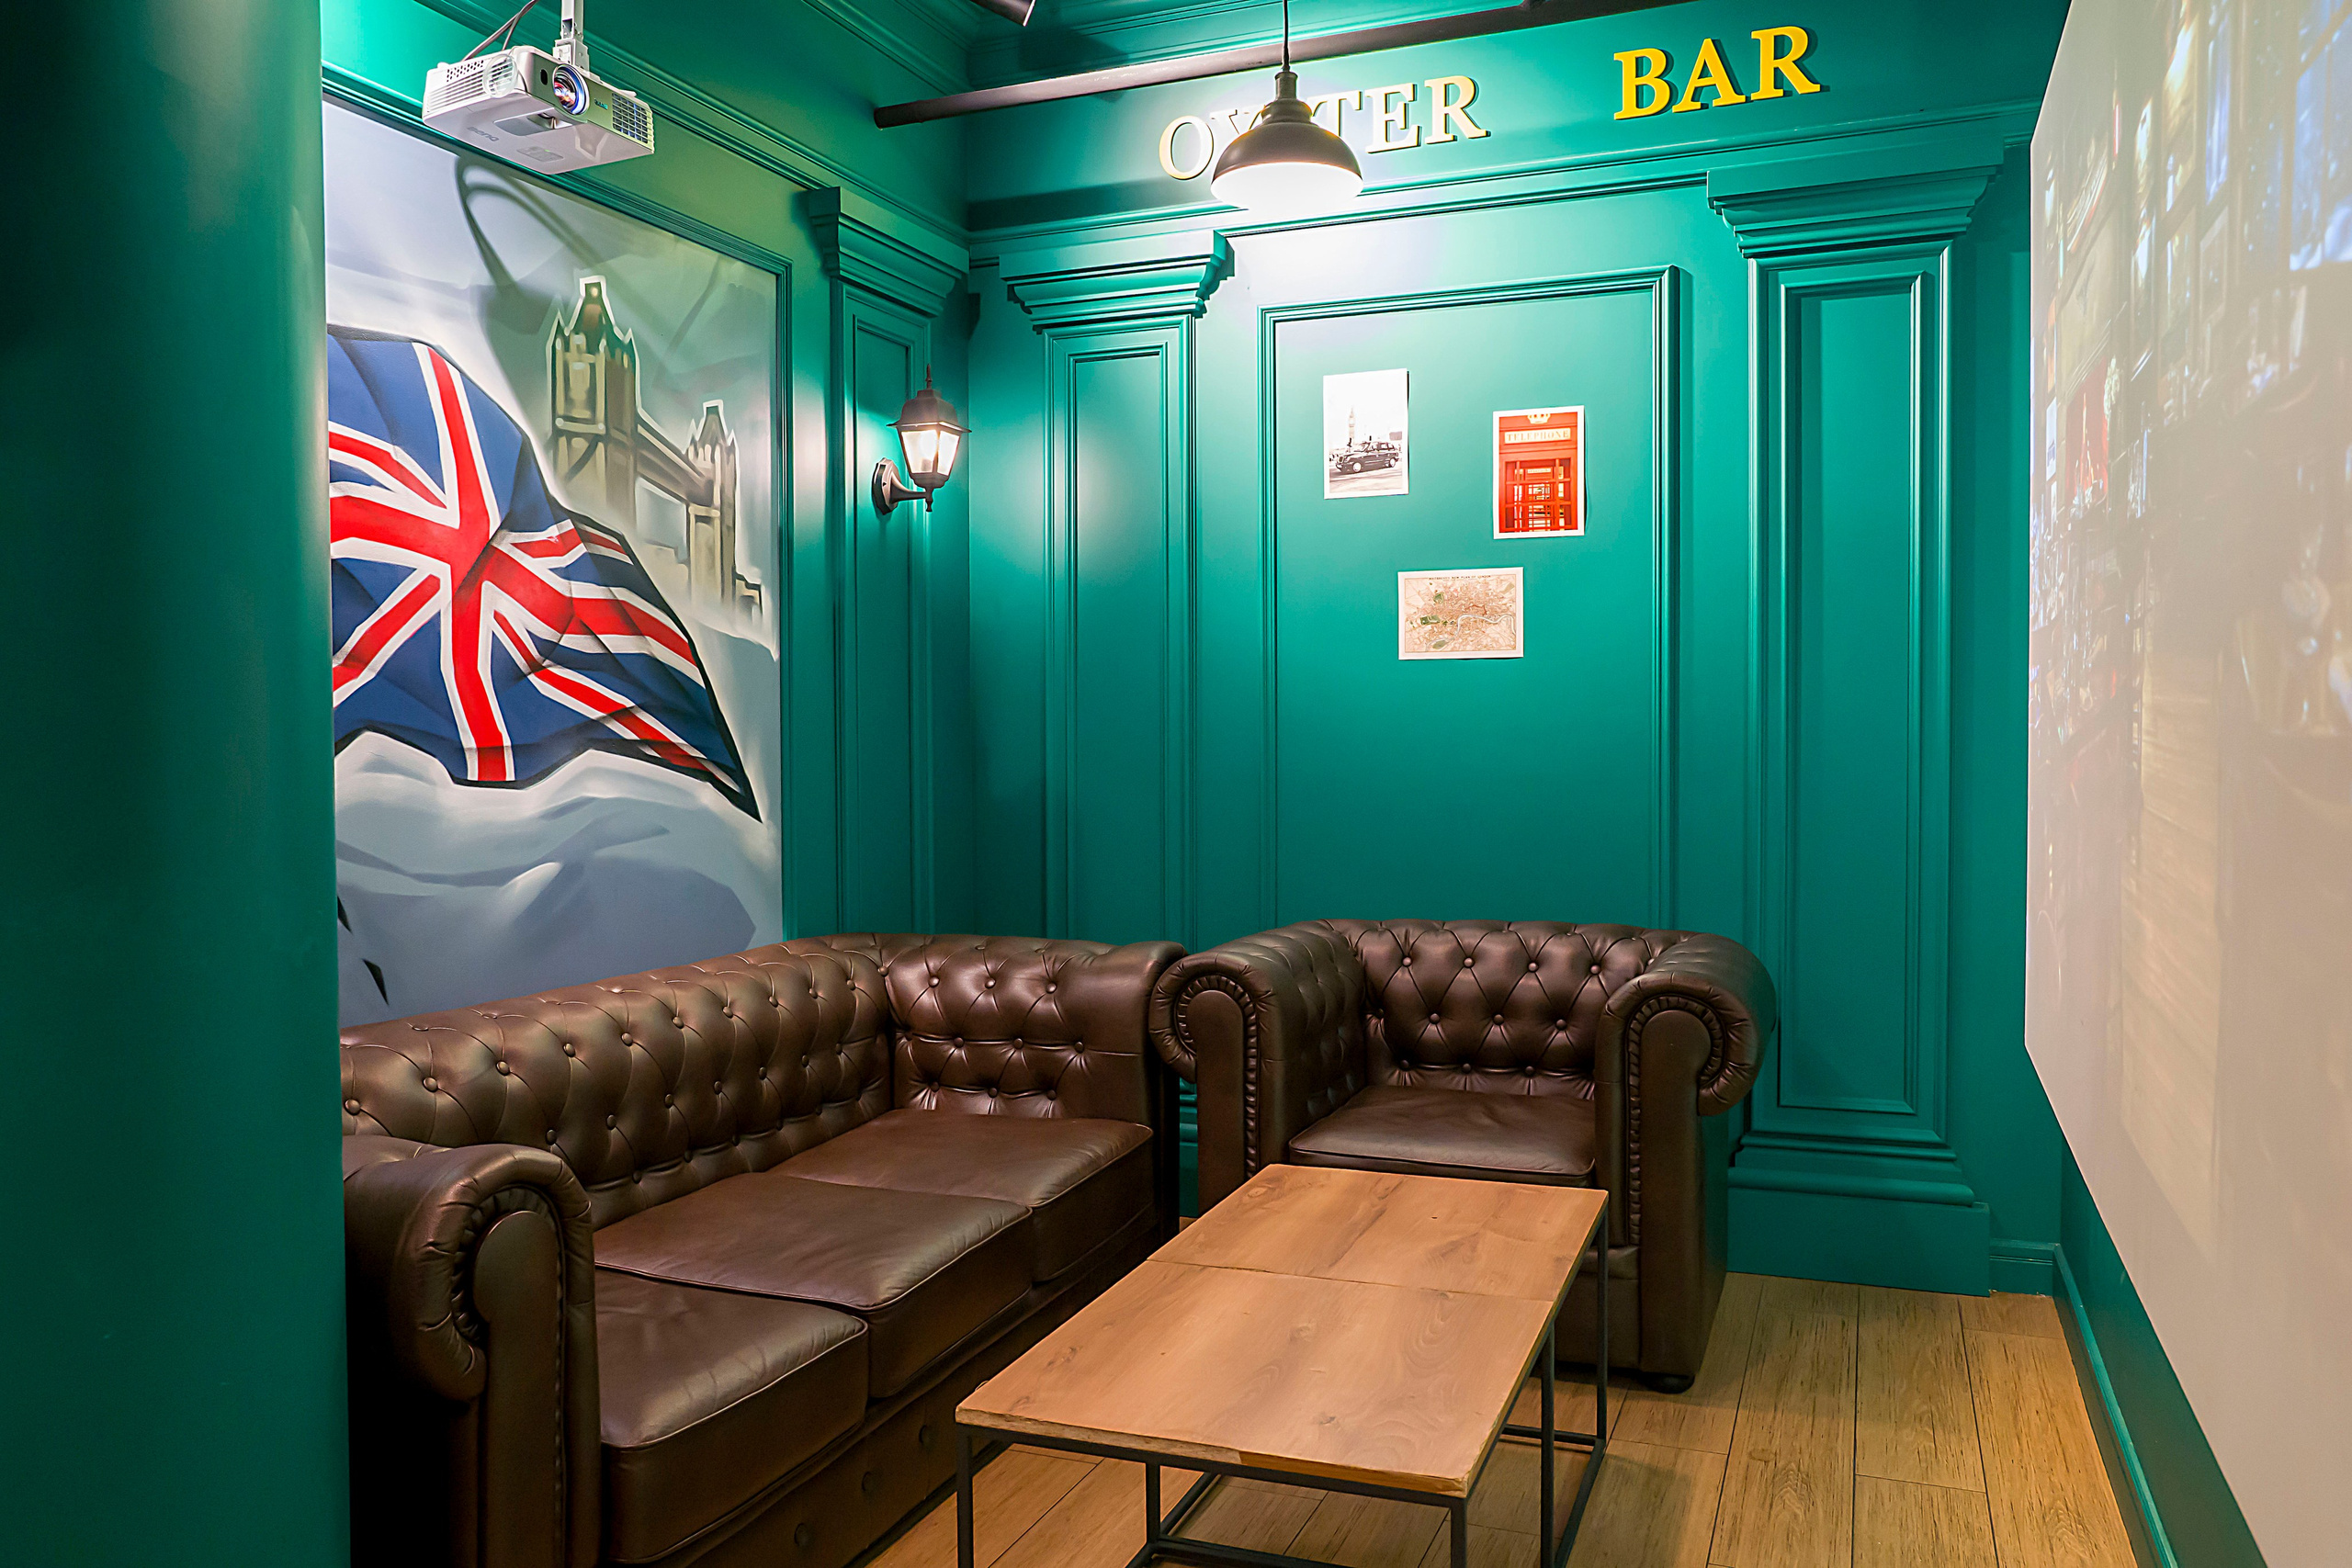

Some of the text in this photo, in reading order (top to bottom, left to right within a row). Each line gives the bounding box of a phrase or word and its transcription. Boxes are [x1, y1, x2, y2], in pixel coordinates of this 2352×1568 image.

[1159, 26, 1822, 180] OYTER BAR
[1507, 430, 1569, 441] TELEPHONE
